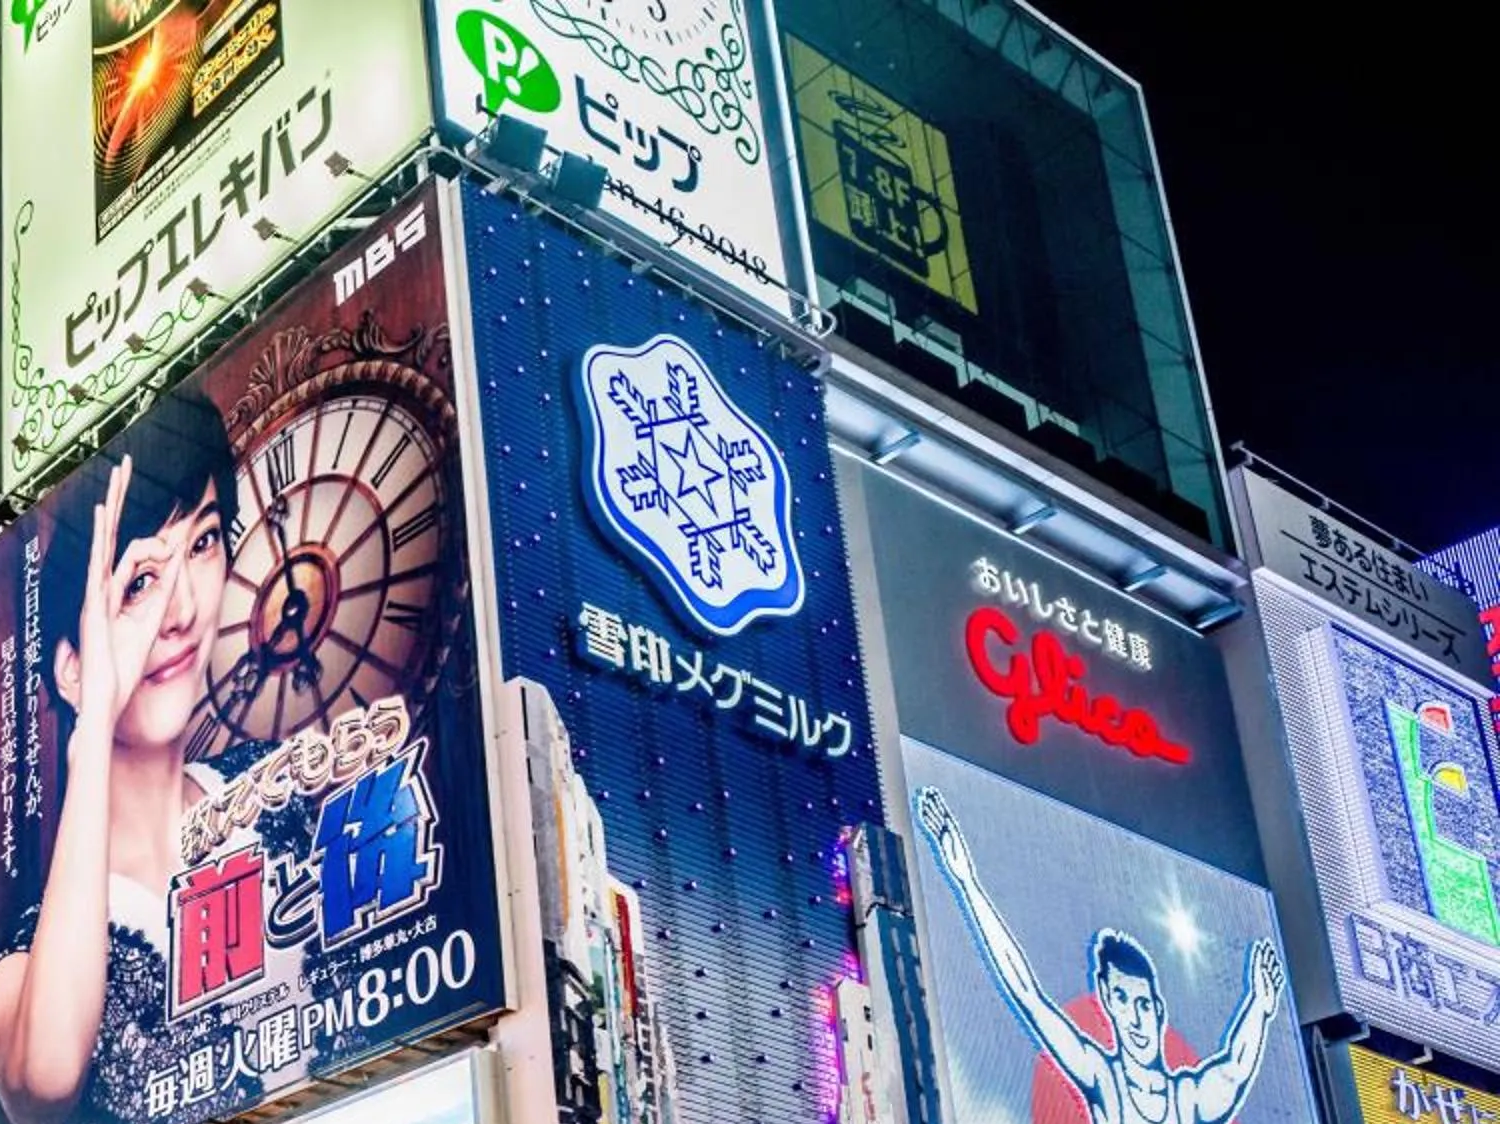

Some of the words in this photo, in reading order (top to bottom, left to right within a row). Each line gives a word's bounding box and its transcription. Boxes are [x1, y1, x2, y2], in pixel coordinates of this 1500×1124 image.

[575, 74, 704, 193] ピップ
[65, 83, 332, 369] ピップエレキバン
[578, 602, 852, 757] 雪印メグミルク
[965, 606, 1193, 766] Glico
[971, 556, 1153, 672] おいしさと健康
[167, 737, 443, 1023] 前と後
[145, 1005, 300, 1118] 毎週火曜
[303, 929, 476, 1050] PM8:00
